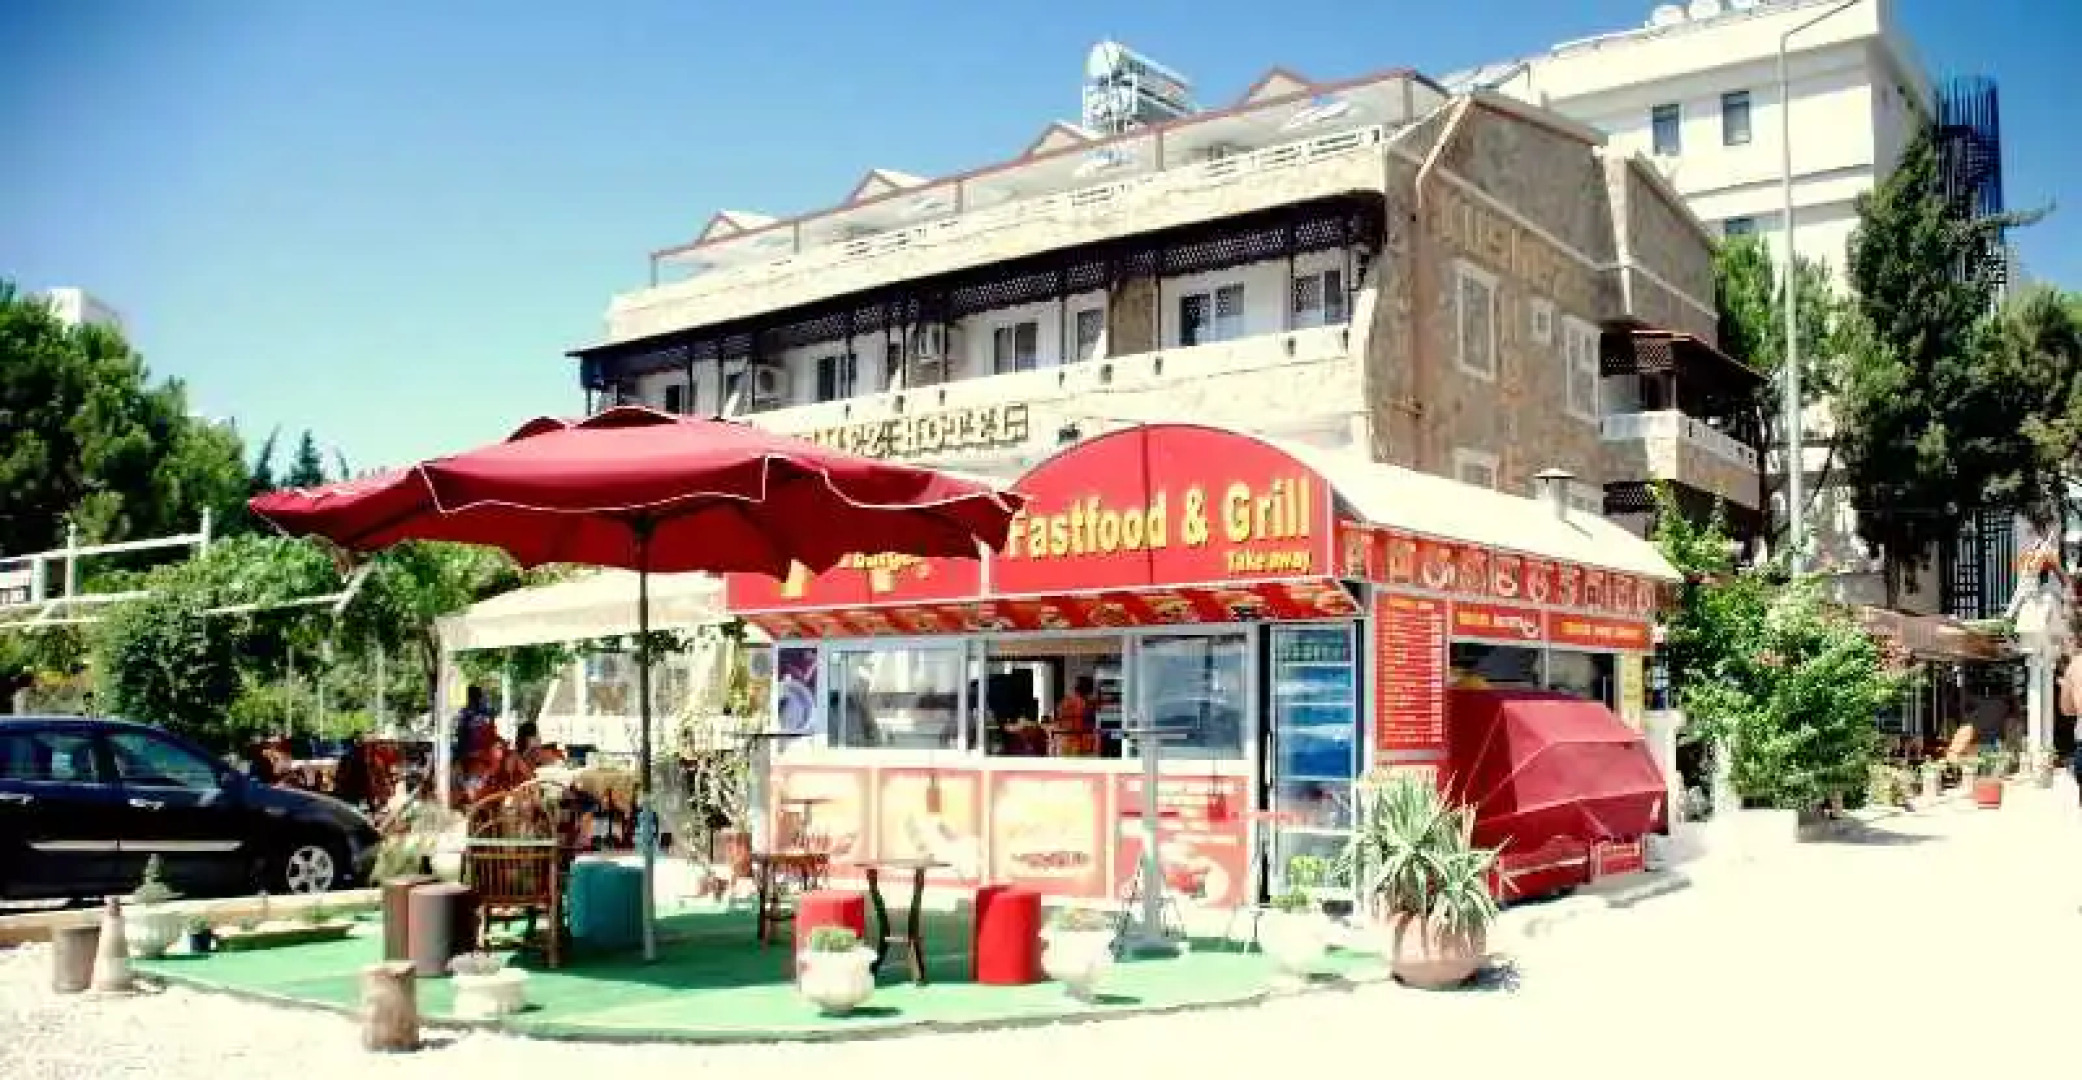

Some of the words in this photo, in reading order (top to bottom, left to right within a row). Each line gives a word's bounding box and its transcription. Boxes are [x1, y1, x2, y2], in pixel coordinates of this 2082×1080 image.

[1009, 490, 1167, 559] Fastfood
[1183, 486, 1208, 547] &
[1226, 477, 1310, 543] Grill
